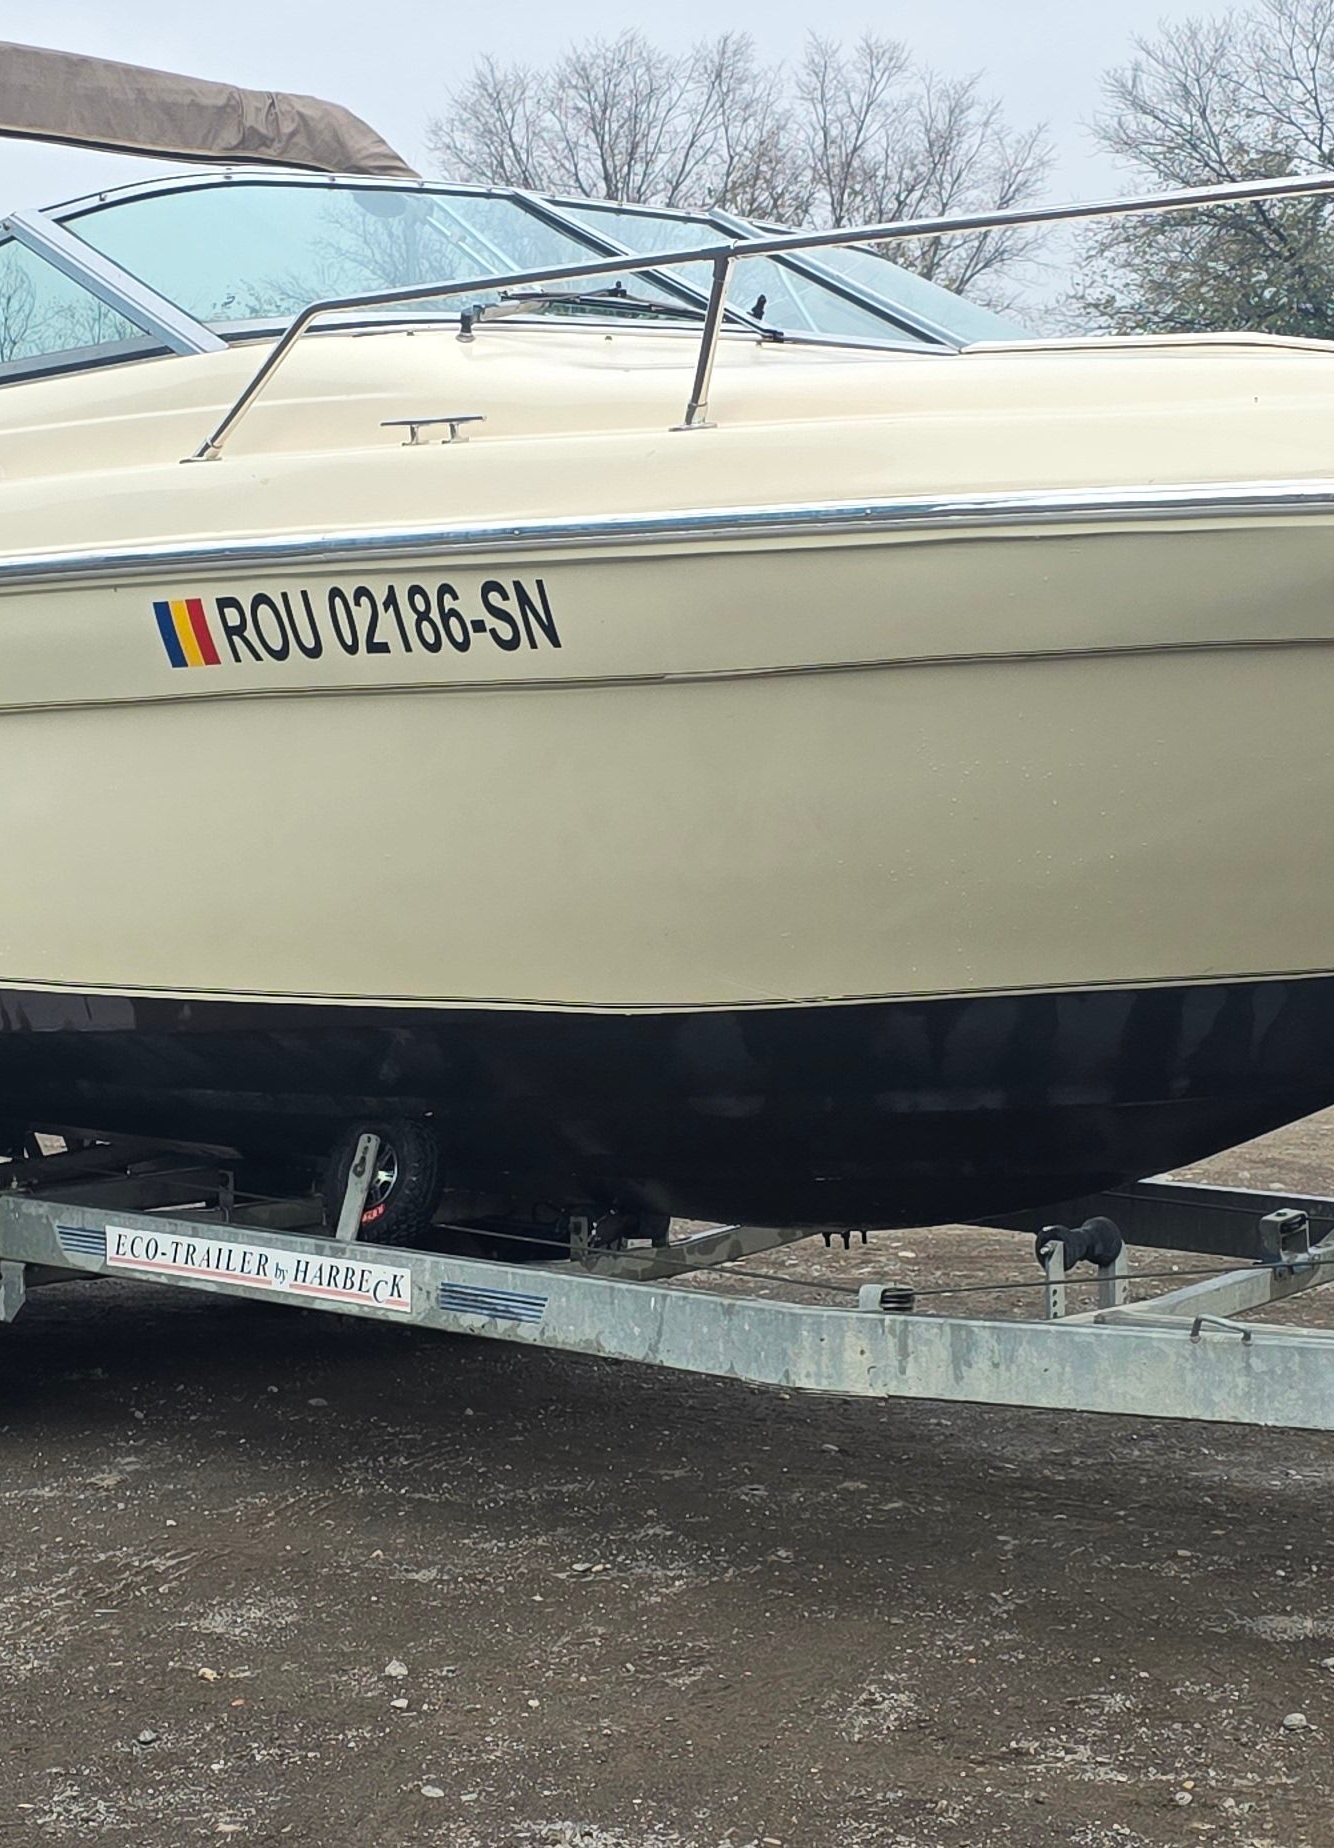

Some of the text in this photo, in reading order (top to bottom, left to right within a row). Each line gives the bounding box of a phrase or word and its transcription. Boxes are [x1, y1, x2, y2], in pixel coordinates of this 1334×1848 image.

[216, 578, 563, 662] ROU 02186-SN
[115, 1234, 406, 1304] ECO-TRAILER by HARBECK
